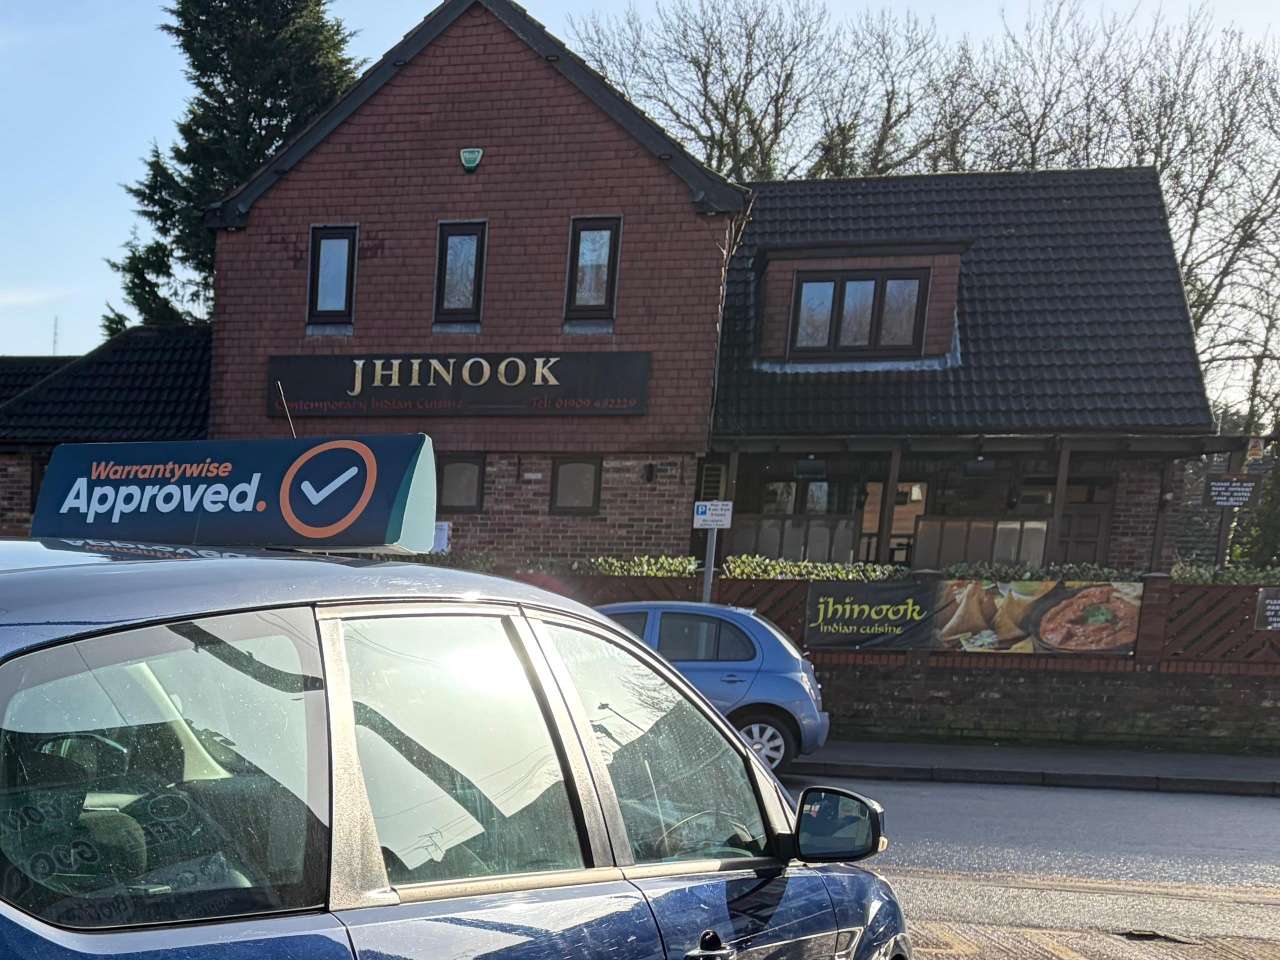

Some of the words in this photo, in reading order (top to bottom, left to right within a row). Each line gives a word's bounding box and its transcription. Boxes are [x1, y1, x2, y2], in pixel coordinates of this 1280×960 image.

[347, 356, 561, 396] JHINOOK
[90, 458, 232, 482] Warrantywise
[59, 472, 267, 523] Approved.
[809, 597, 927, 627] jhinook
